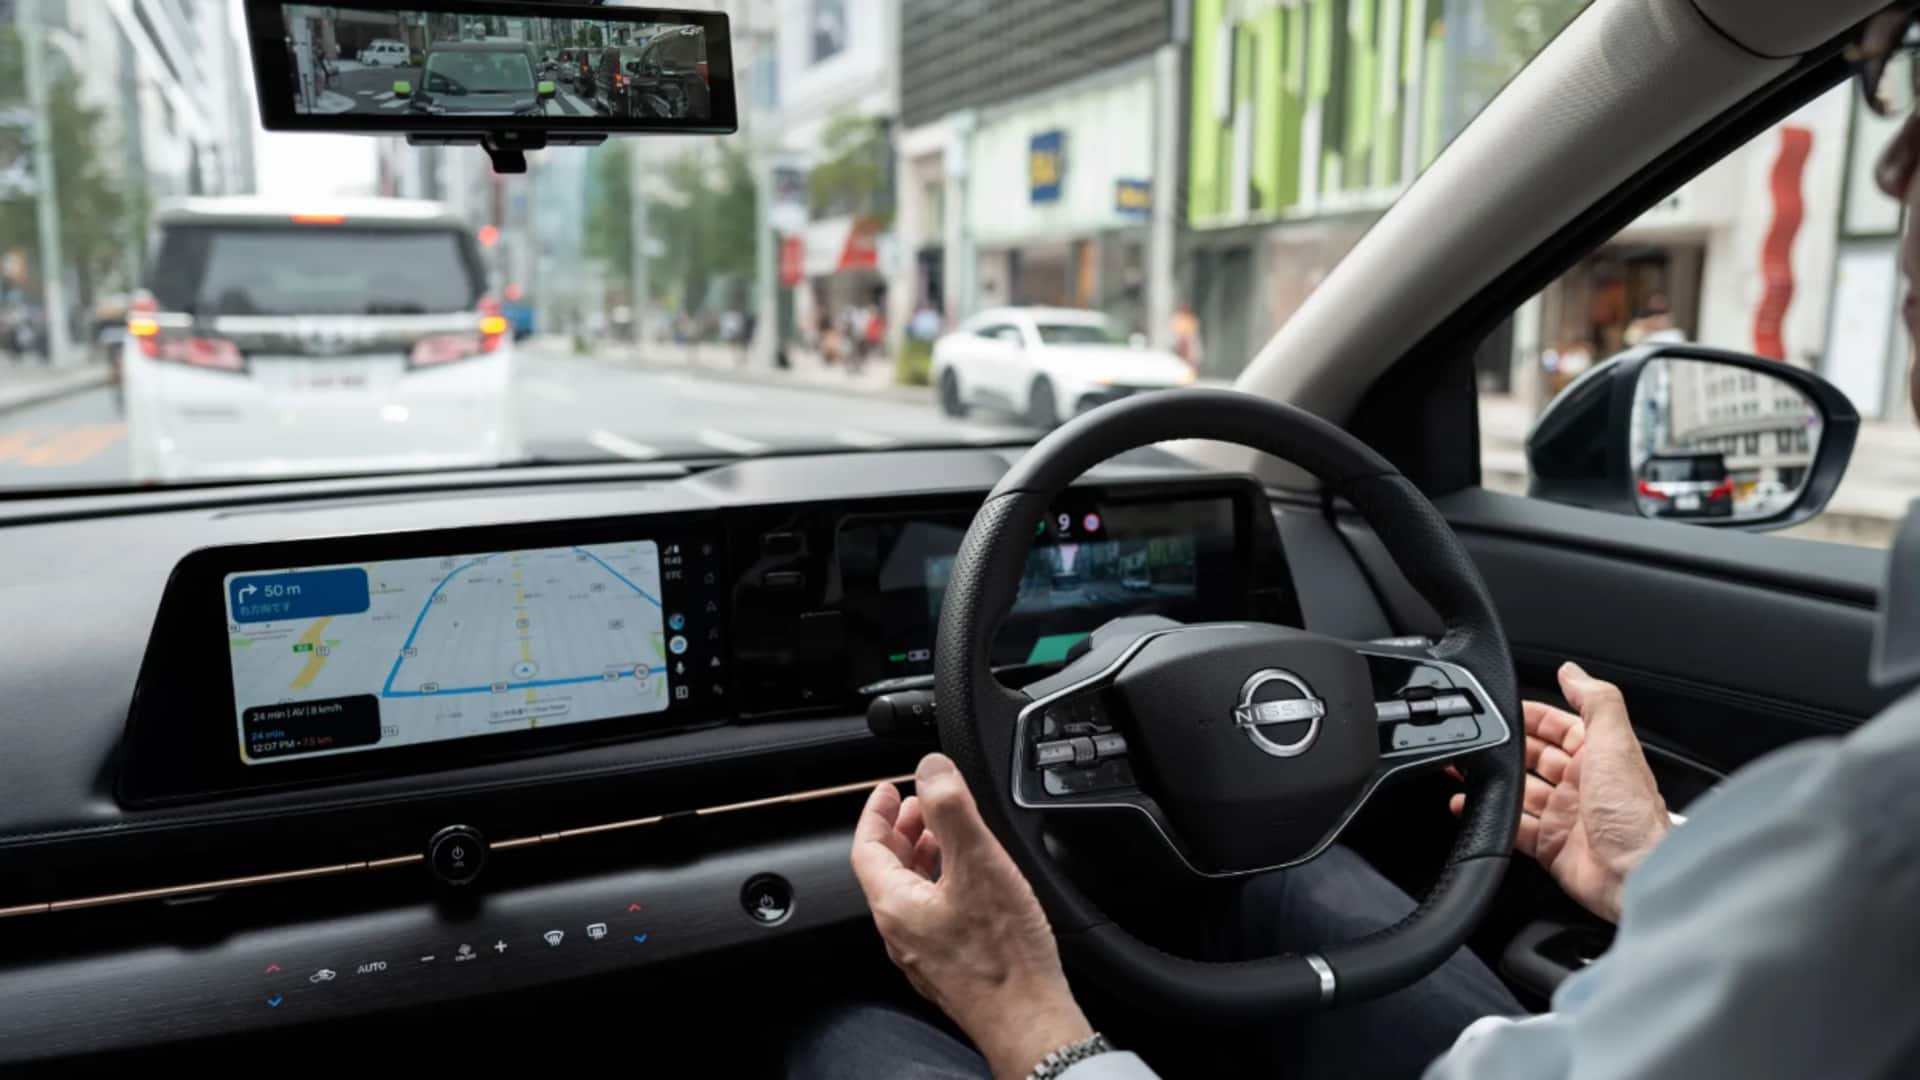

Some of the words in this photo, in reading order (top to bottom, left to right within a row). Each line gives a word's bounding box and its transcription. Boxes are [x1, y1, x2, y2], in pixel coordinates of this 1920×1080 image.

[1058, 513, 1070, 531] 9
[264, 584, 283, 598] 50
[287, 584, 301, 596] m
[253, 712, 266, 722] 24
[267, 710, 286, 720] min
[1235, 701, 1325, 724] NISSN
[252, 742, 277, 752] 12:07
[280, 739, 295, 749] PM
[357, 961, 387, 974] AUTO
